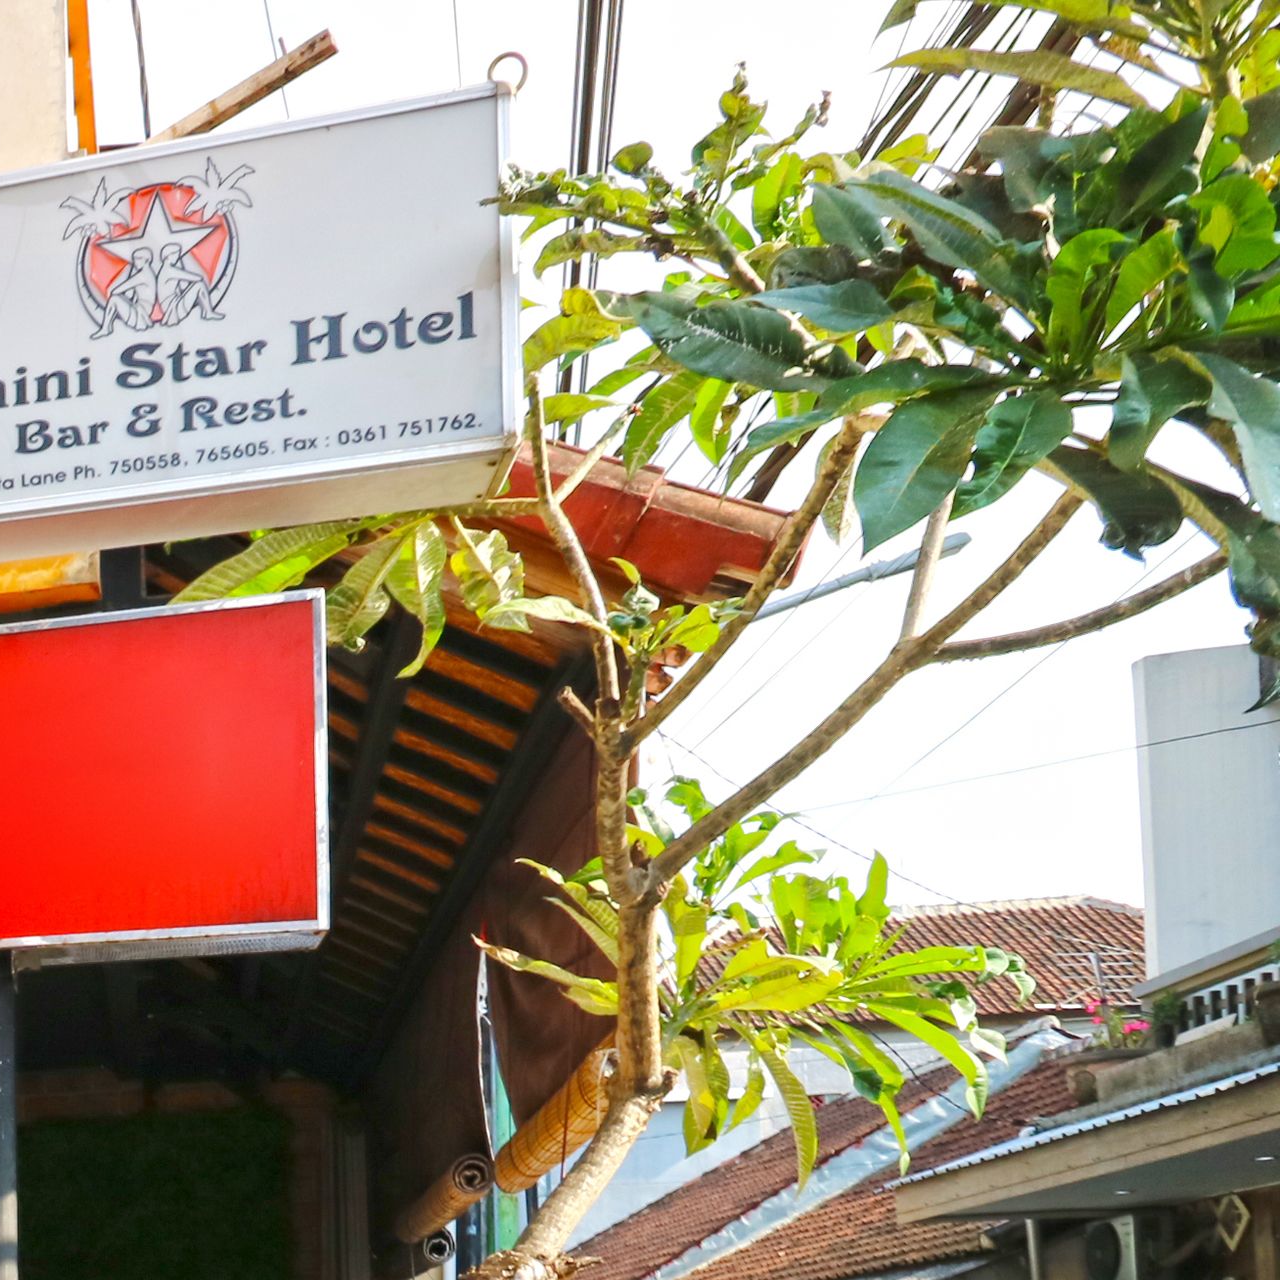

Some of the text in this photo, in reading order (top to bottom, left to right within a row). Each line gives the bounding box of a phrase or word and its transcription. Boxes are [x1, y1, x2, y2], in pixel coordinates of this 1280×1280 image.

[115, 340, 267, 391] Star
[290, 291, 478, 366] Hotel
[15, 387, 308, 454] Bar & Rest.
[21, 471, 67, 488] Lane
[73, 464, 102, 480] Ph.
[109, 453, 189, 476] 750558,
[196, 441, 276, 464] 765605.
[283, 437, 318, 453] Fax
[338, 425, 387, 446] 0361
[397, 412, 483, 438] 751762.
